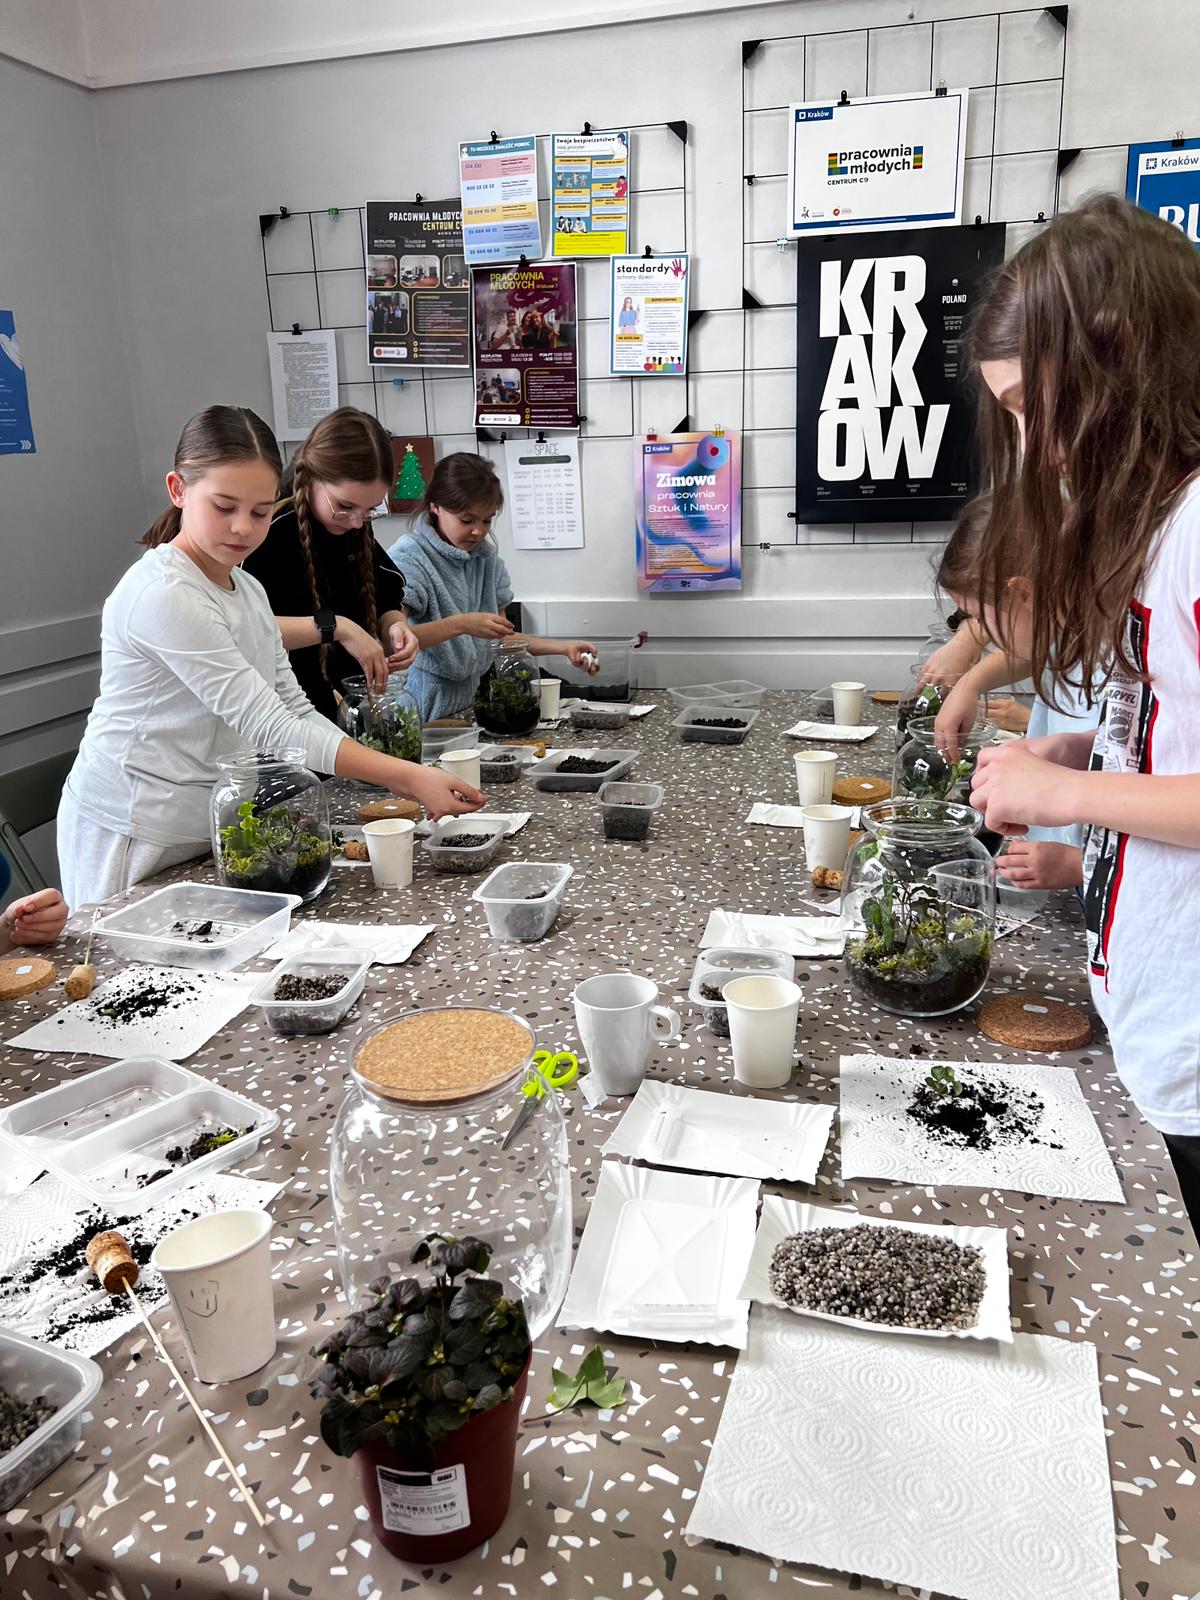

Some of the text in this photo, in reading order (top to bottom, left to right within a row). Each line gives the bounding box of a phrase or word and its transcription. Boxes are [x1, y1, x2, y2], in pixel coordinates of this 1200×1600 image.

[839, 143, 912, 164] pracownia
[850, 158, 911, 175] młodych
[1161, 155, 1199, 167] Kraków
[388, 212, 430, 221] PRACOWNIA
[422, 221, 454, 231] CENTRUM
[616, 263, 670, 274] standardy
[490, 271, 545, 281] PRACOWNIA
[942, 294, 967, 304] POLAND
[656, 473, 716, 487] Zimowa
[657, 490, 715, 501] pracownia
[689, 503, 729, 512] Natury
